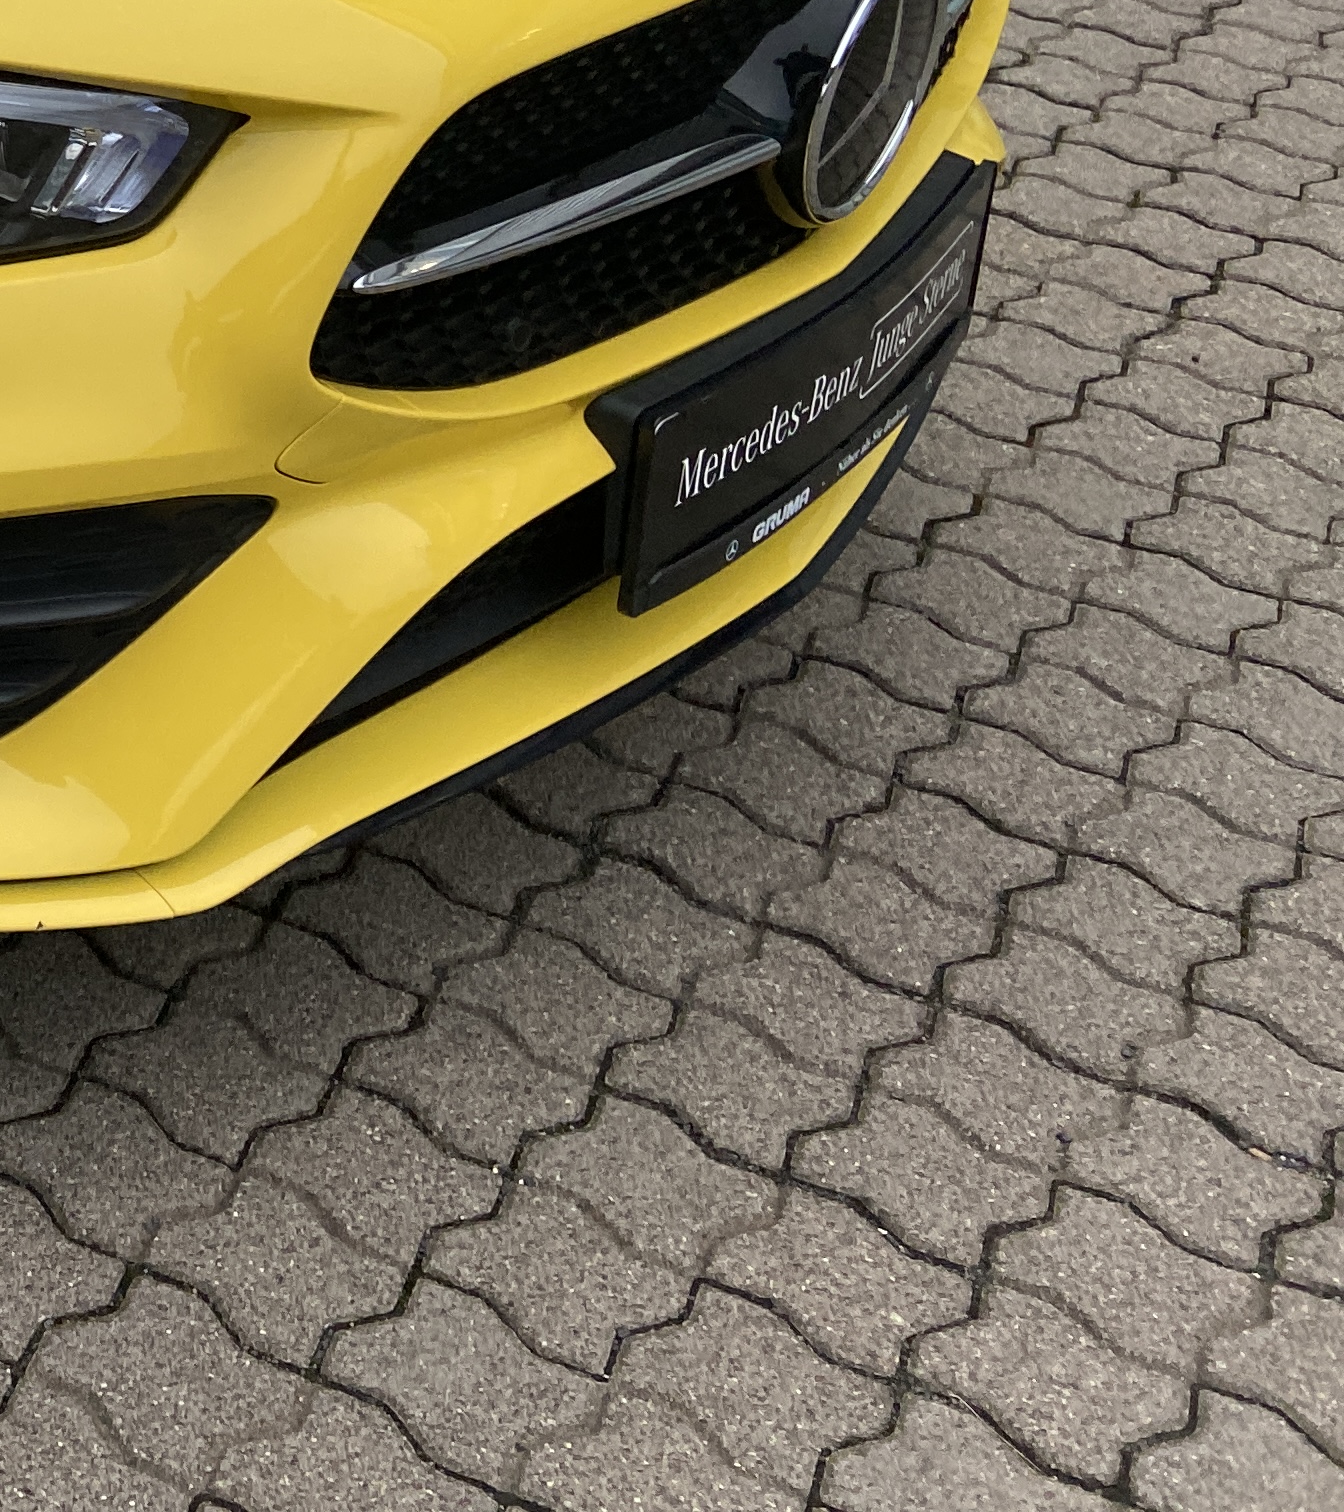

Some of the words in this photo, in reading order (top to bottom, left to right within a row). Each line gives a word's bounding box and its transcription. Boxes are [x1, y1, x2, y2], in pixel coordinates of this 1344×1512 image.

[674, 355, 864, 508] Mercedes-Benz
[866, 304, 920, 384] Junge
[918, 249, 966, 325] Sterne
[752, 486, 811, 543] GRUMA
